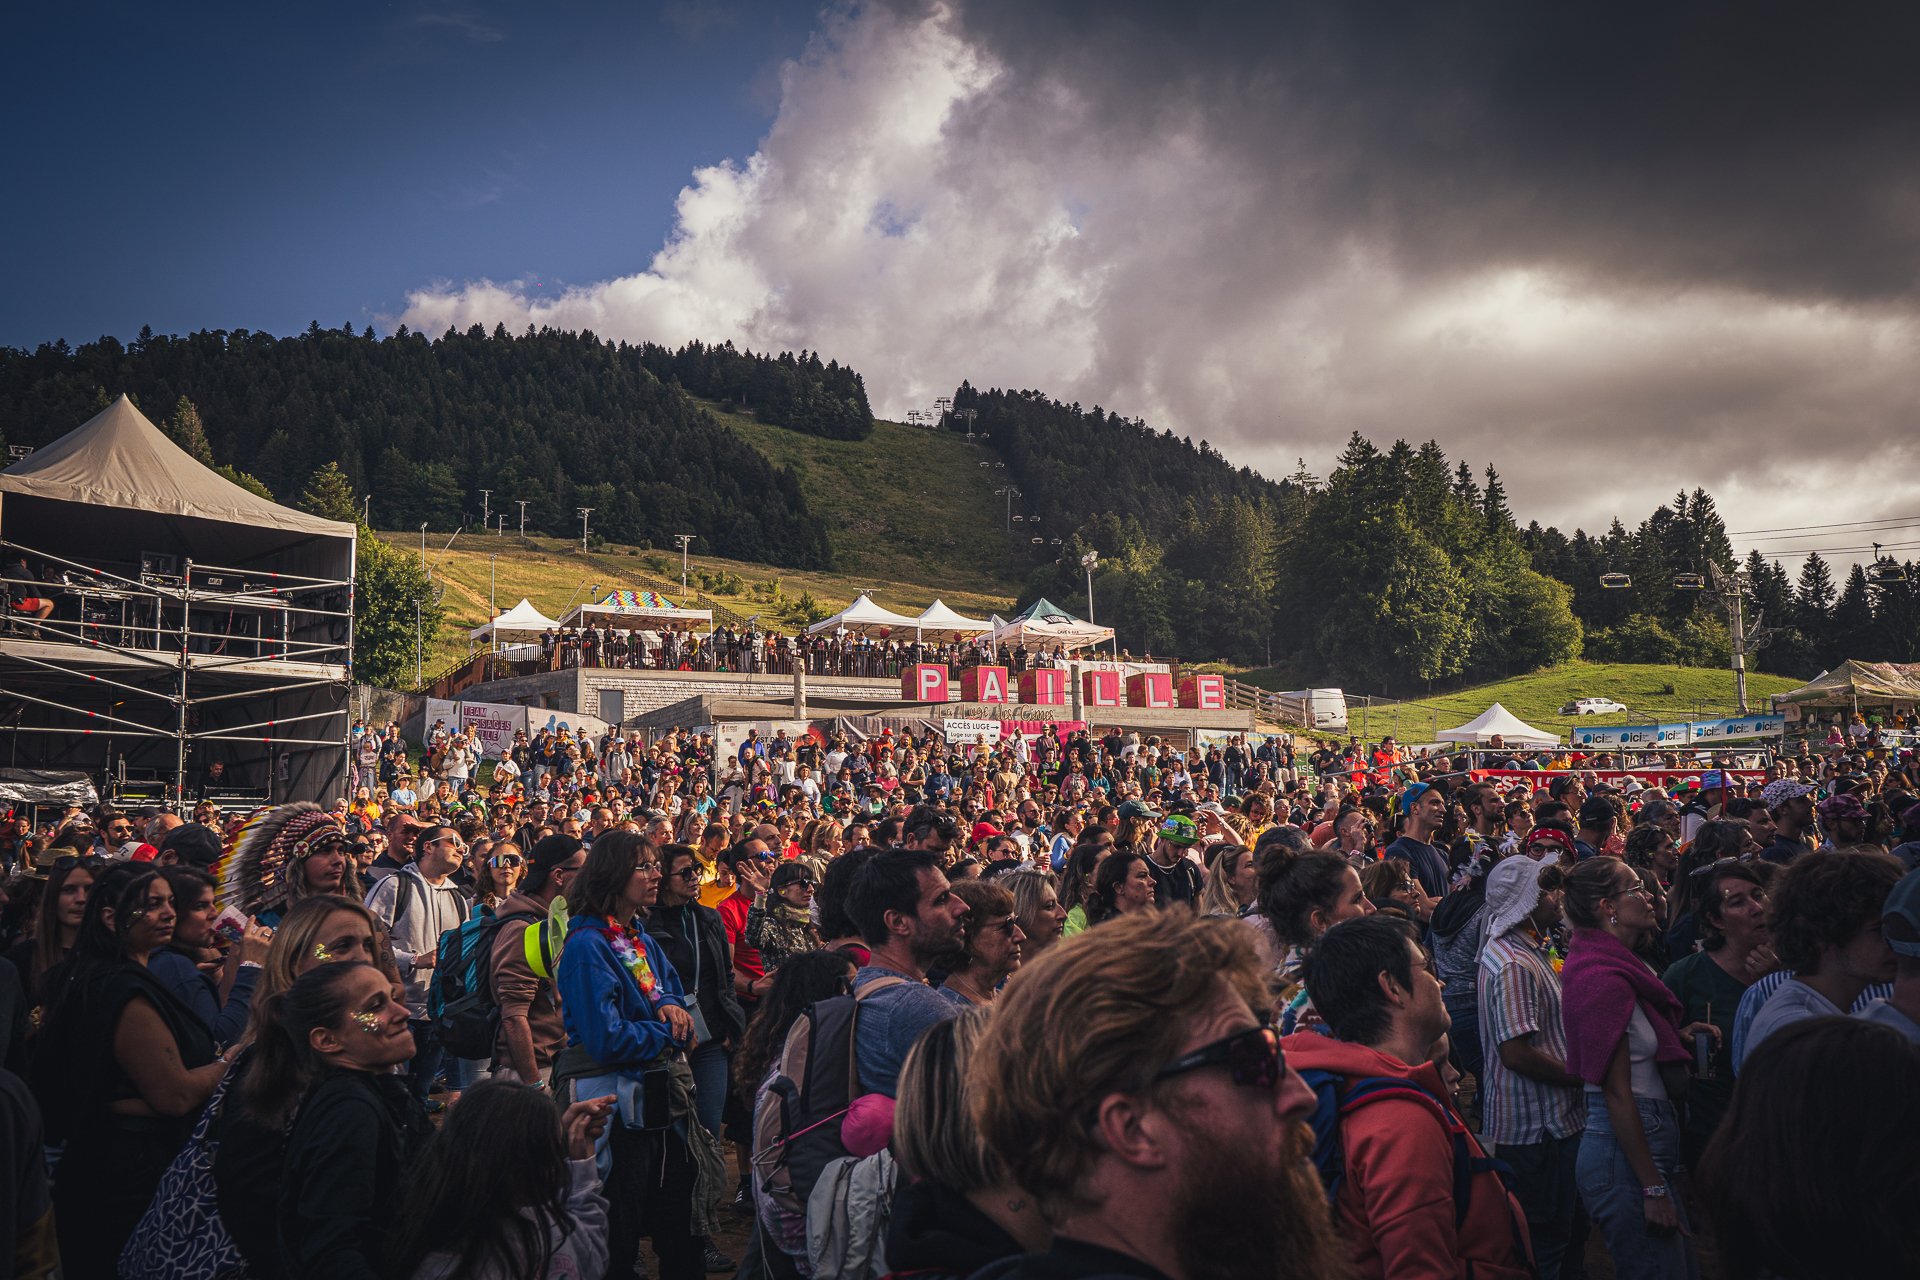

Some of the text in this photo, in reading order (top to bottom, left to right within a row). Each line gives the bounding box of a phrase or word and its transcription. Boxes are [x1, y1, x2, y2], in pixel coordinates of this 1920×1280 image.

[464, 706, 487, 717] TEAM
[464, 718, 511, 730] MSSAGES
[946, 721, 990, 731] ACCÈS LUGE
[1733, 723, 1744, 734] ici
[1762, 721, 1773, 731] ici
[1630, 732, 1642, 742] ici
[1665, 730, 1676, 741] ici
[1704, 726, 1714, 737] ici
[1592, 733, 1605, 743] ici
